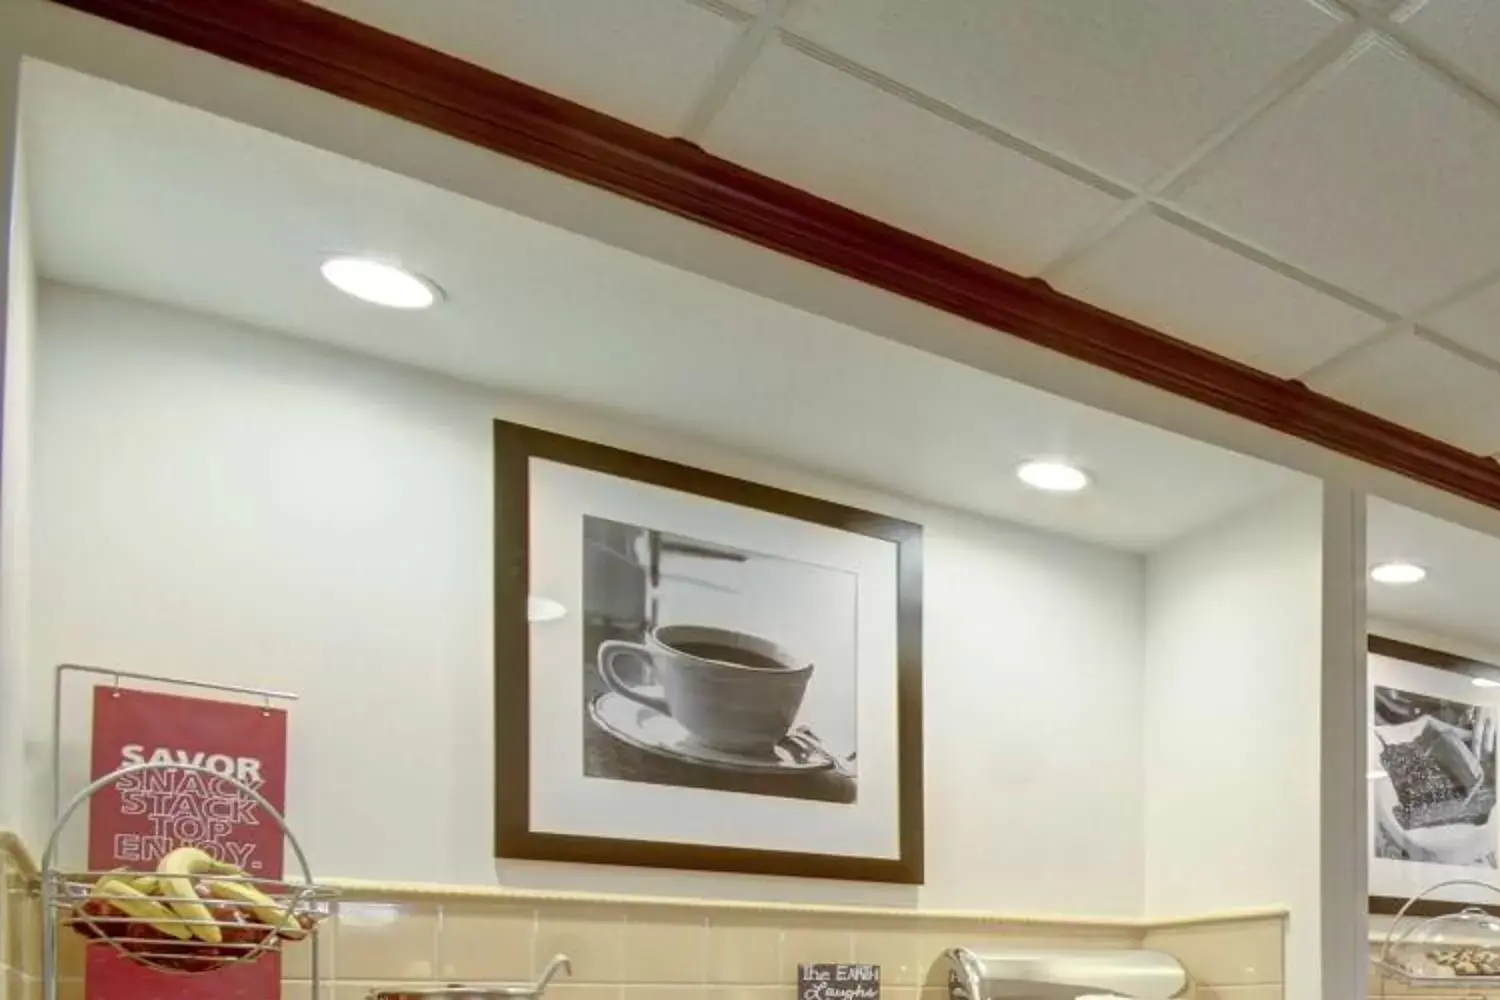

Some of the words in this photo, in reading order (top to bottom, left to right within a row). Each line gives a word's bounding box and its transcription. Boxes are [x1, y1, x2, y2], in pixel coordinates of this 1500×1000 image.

[119, 744, 263, 782] SAVOR
[116, 768, 265, 801] SNACK
[121, 790, 260, 825] STACK
[148, 814, 233, 842] TOP
[114, 834, 263, 869] ENOY.
